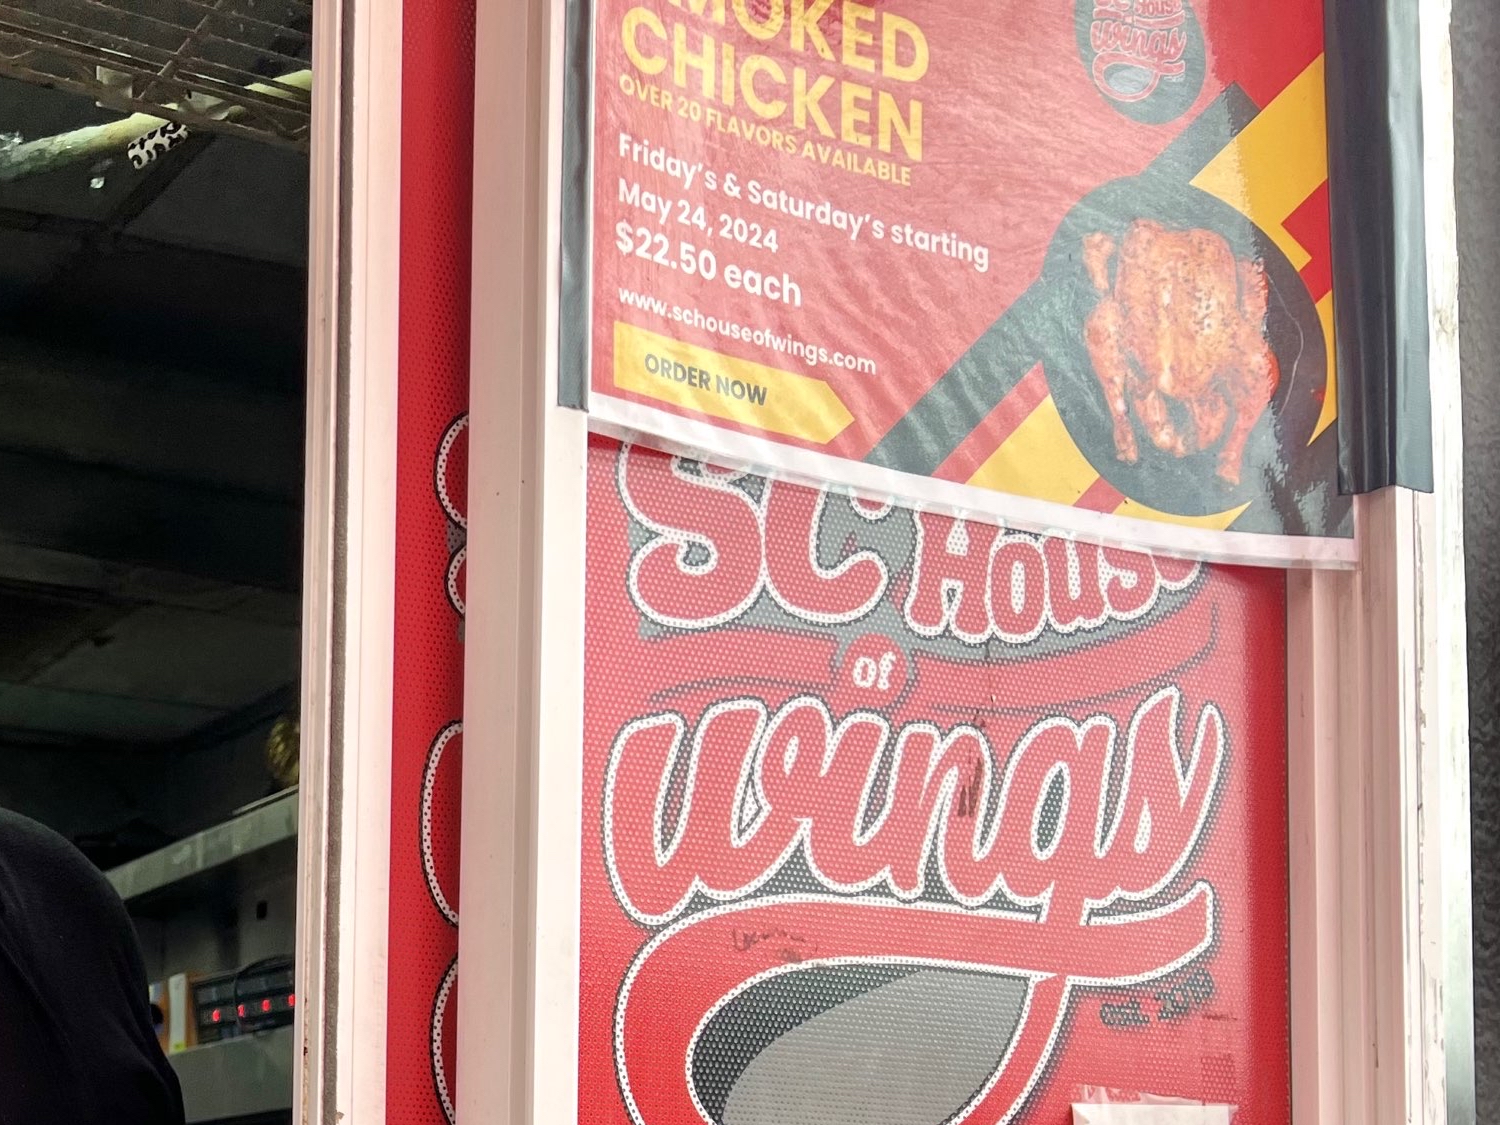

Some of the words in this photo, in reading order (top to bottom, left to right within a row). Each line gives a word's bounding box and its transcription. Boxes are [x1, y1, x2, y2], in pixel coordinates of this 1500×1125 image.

[621, 7, 923, 162] CHICKEN
[618, 74, 672, 110] OVER
[677, 96, 702, 122] 20
[706, 108, 797, 153] FLAVORS
[801, 140, 912, 187] AVAILABLE
[618, 132, 717, 192] Friday's
[723, 173, 742, 200] &
[747, 180, 885, 241] Saturday's
[890, 224, 990, 273] starting
[618, 178, 672, 223] May
[677, 199, 714, 238] 24,
[719, 213, 779, 254] 2024
[615, 220, 717, 281] $22.50
[724, 262, 802, 307] each
[618, 286, 877, 376] www.schouseofwings.com
[644, 353, 711, 392] ORDER
[715, 369, 768, 406] NOW
[852, 651, 896, 691] of
